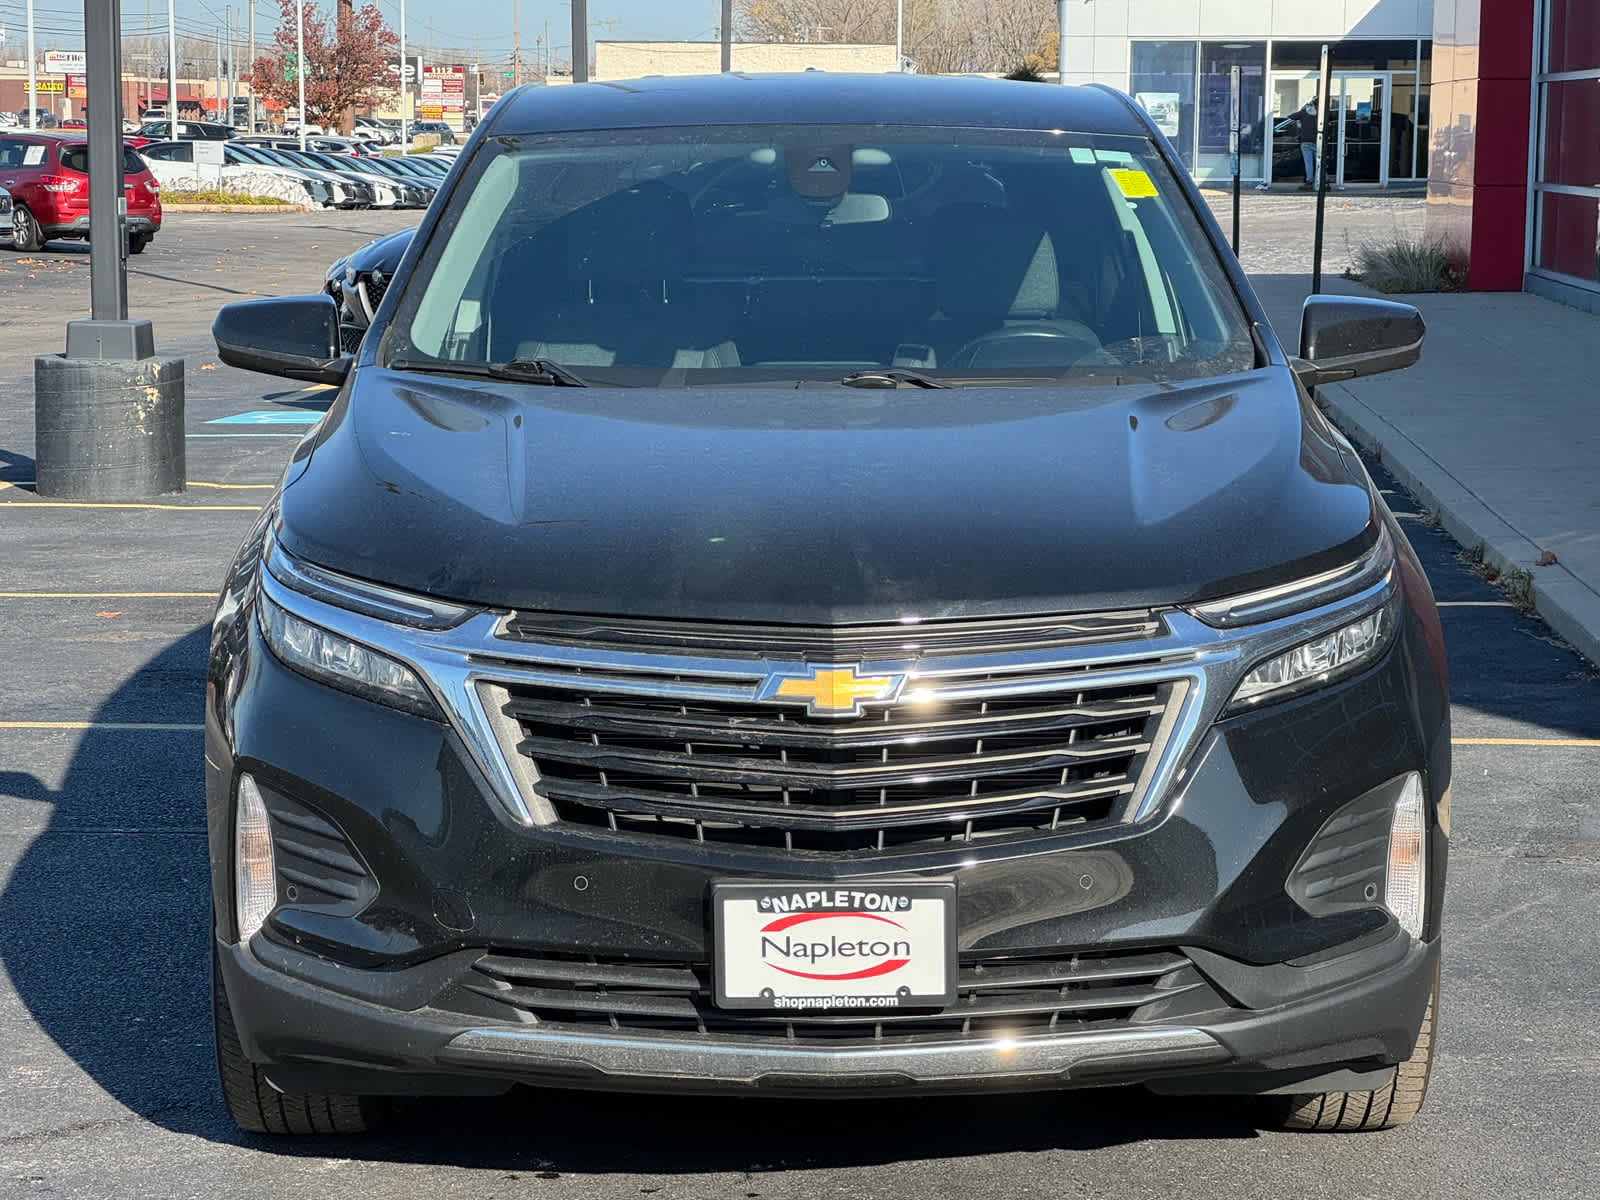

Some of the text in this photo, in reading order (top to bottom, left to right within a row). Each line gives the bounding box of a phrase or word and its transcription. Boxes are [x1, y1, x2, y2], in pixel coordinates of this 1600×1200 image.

[772, 890, 899, 913] NAPLETON
[761, 935, 911, 964] Napleton
[773, 994, 899, 1009] shopnapleton.com
